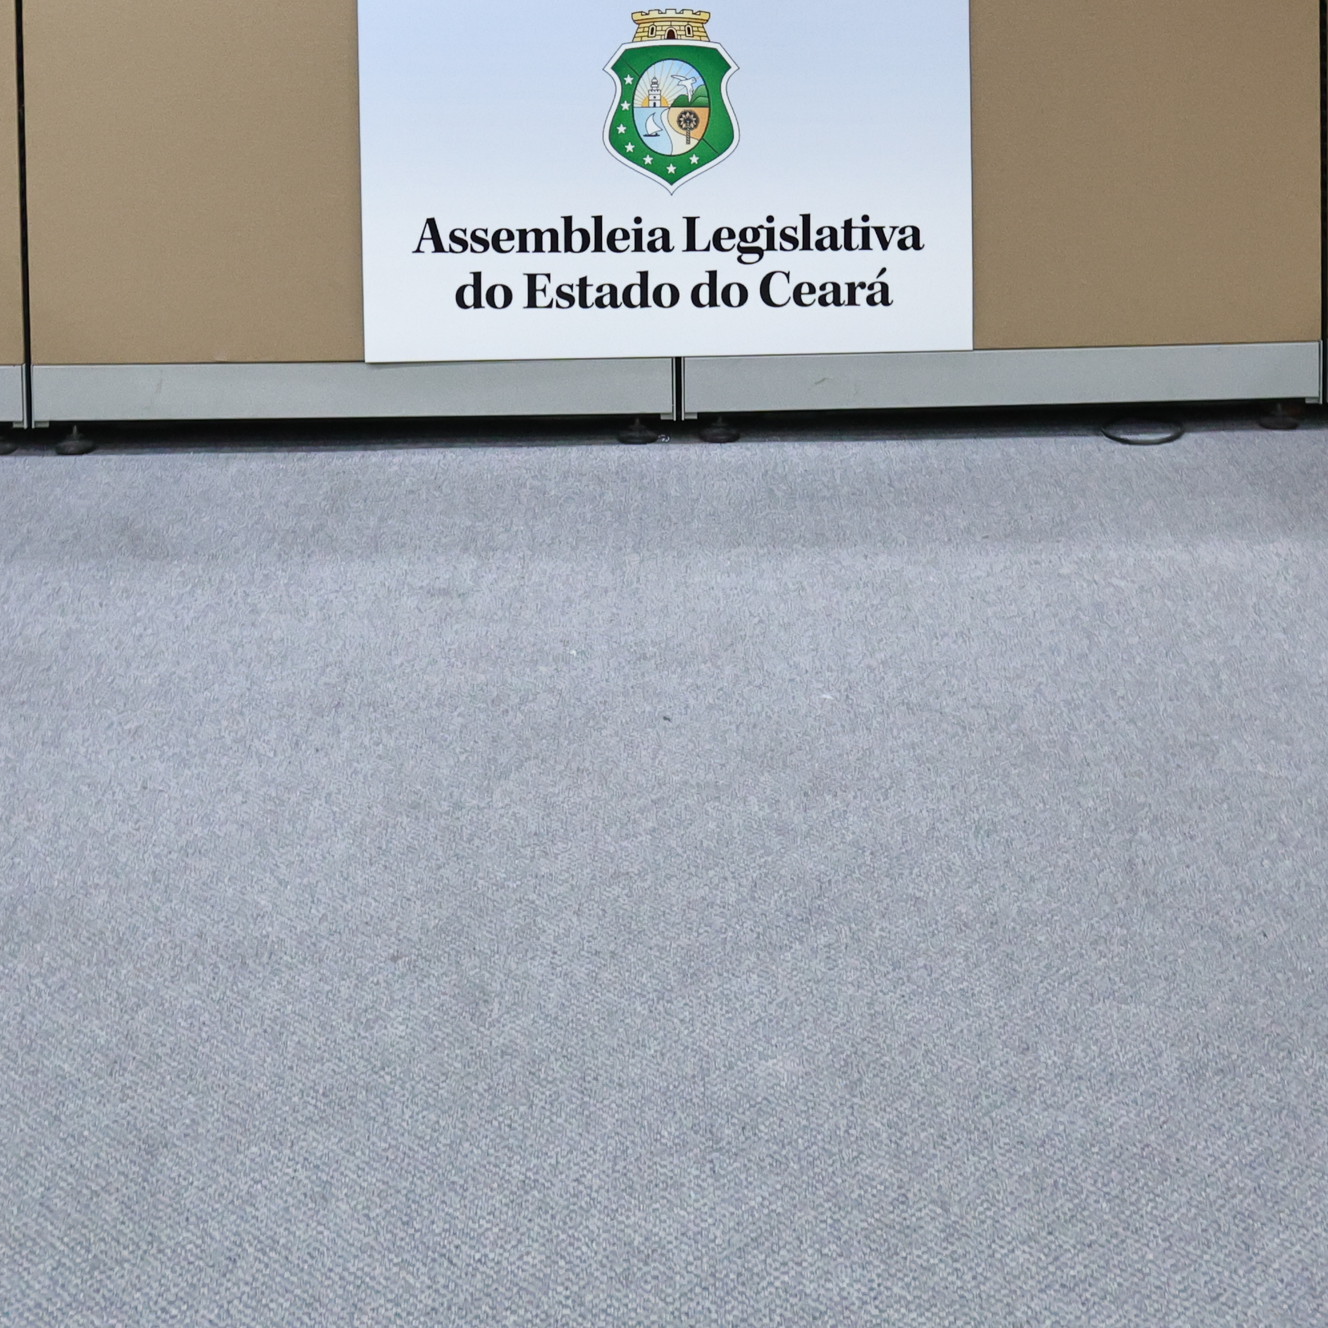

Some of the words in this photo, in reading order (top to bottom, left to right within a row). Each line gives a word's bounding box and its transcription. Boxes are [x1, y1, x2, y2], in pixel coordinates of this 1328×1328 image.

[412, 215, 675, 254] Assembleia
[682, 213, 925, 265] Legislativa
[455, 271, 513, 310] do
[523, 270, 680, 309] Estado
[690, 269, 749, 309] do
[759, 267, 894, 308] Ceará
